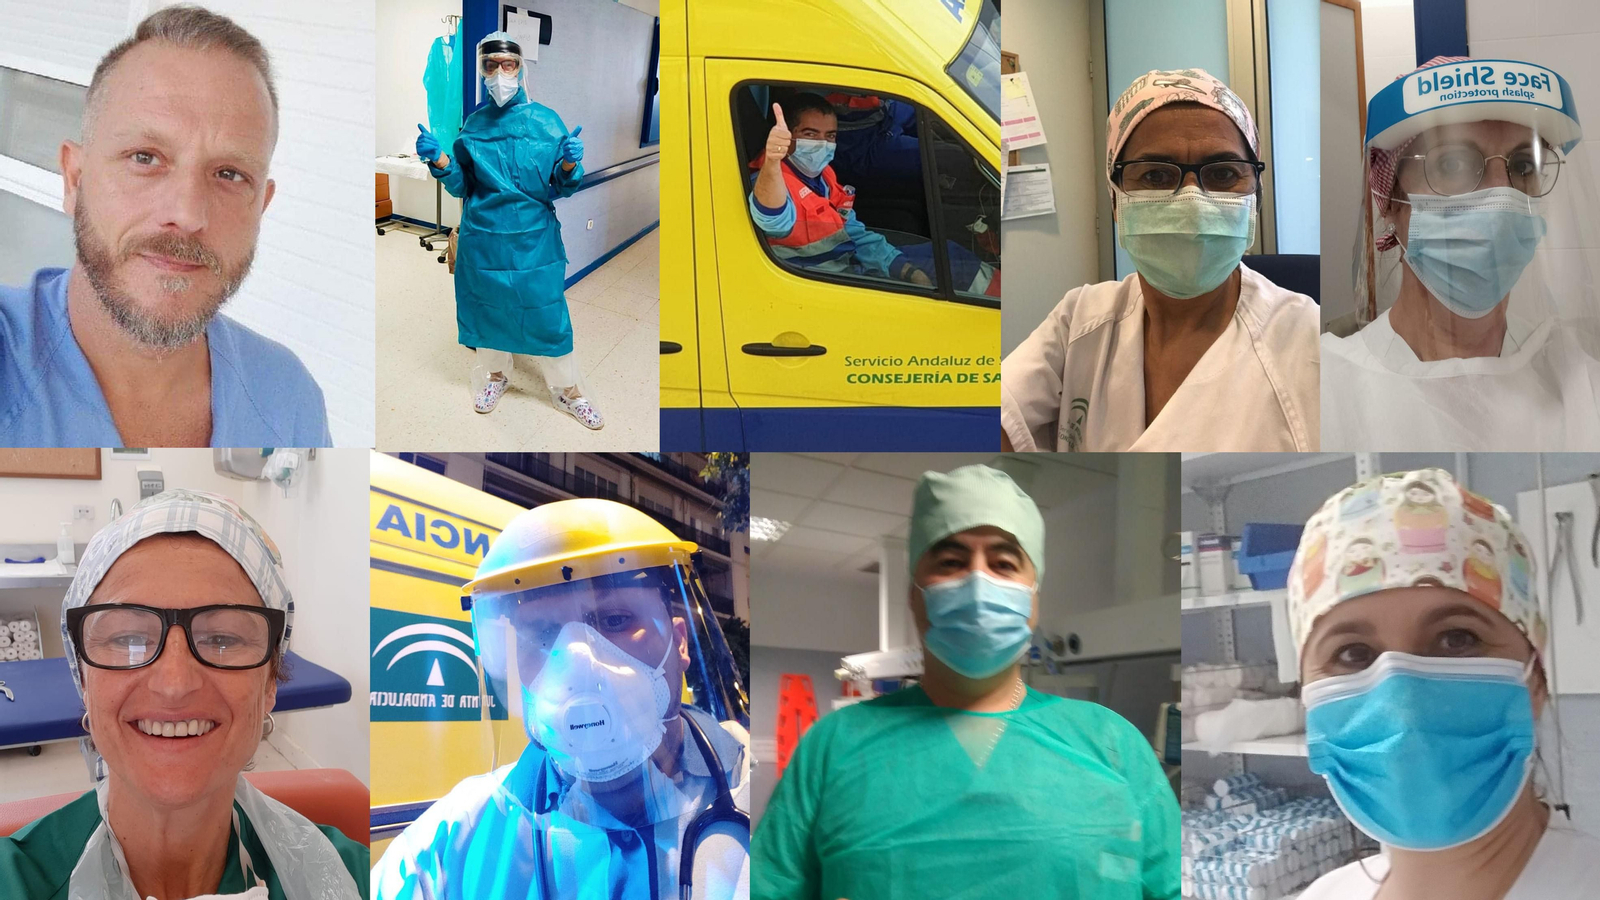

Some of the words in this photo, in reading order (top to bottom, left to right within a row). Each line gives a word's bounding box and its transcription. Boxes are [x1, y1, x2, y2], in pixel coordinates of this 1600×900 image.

[844, 356, 903, 367] Servicio
[907, 355, 971, 366] Andaluz
[976, 355, 995, 366] de
[846, 371, 953, 384] CONSEJERÍA
[956, 373, 979, 384] DE
[983, 372, 1001, 384] SA
